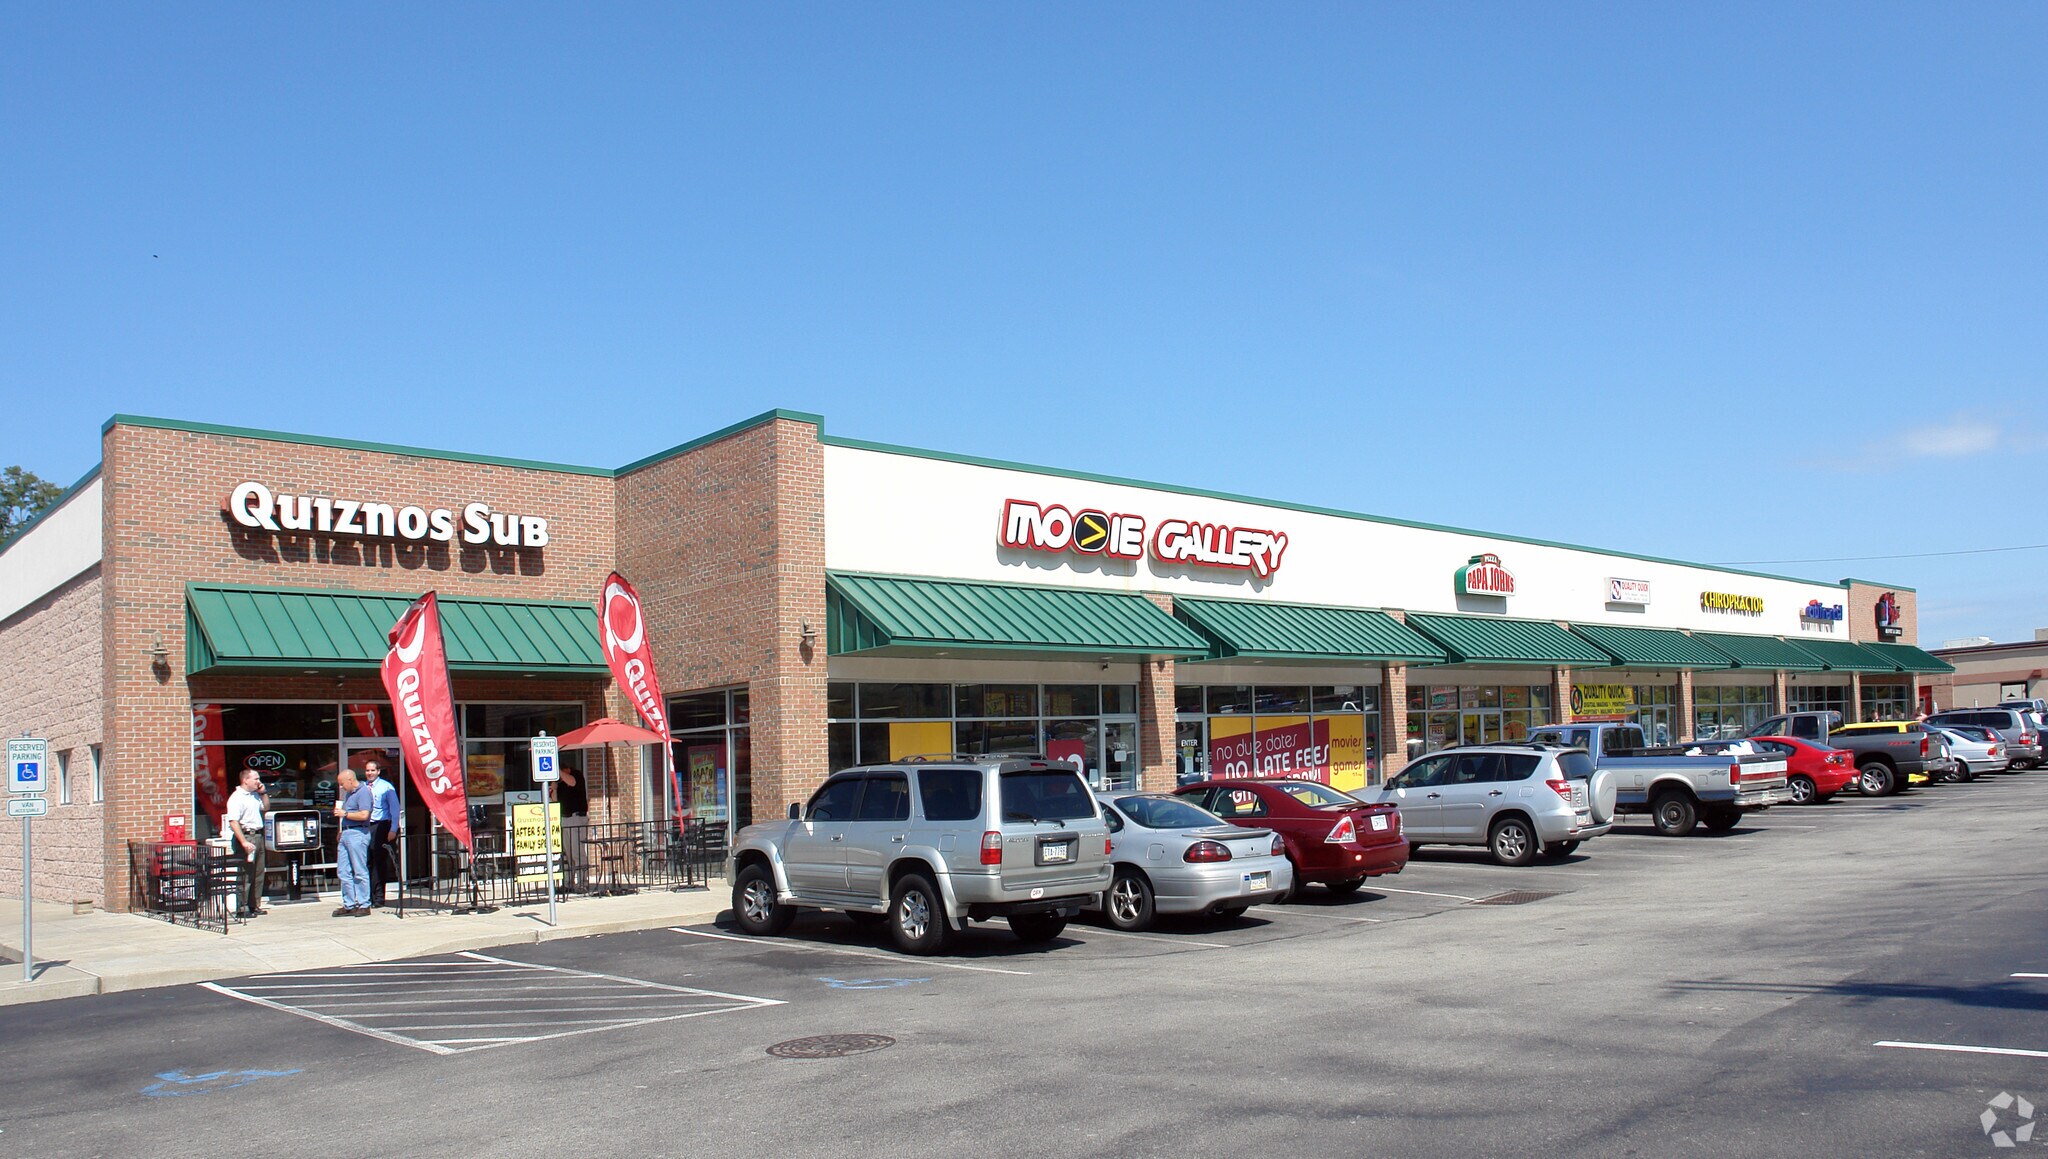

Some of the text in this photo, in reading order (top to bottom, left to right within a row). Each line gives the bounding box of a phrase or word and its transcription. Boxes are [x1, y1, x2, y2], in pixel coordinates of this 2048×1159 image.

[1154, 519, 1288, 579] GALLERY
[1468, 567, 1488, 590] PAPA
[1704, 591, 1764, 612] CHIROPRACTOR
[1583, 685, 1626, 699] QUALITY QUICK
[9, 743, 45, 752] RESERVED
[1181, 739, 1198, 747] ENTER
[1216, 746, 1233, 760] no
[1266, 734, 1298, 751] dates
[1331, 734, 1362, 748] movies
[12, 752, 42, 760] PARKING
[248, 755, 281, 767] OPEN
[1255, 752, 1292, 778] LATE
[1296, 744, 1329, 769] FEES
[1333, 761, 1362, 776] games
[516, 826, 535, 837] AFTER
[552, 825, 561, 835] PM
[516, 840, 536, 851] FAMILY
